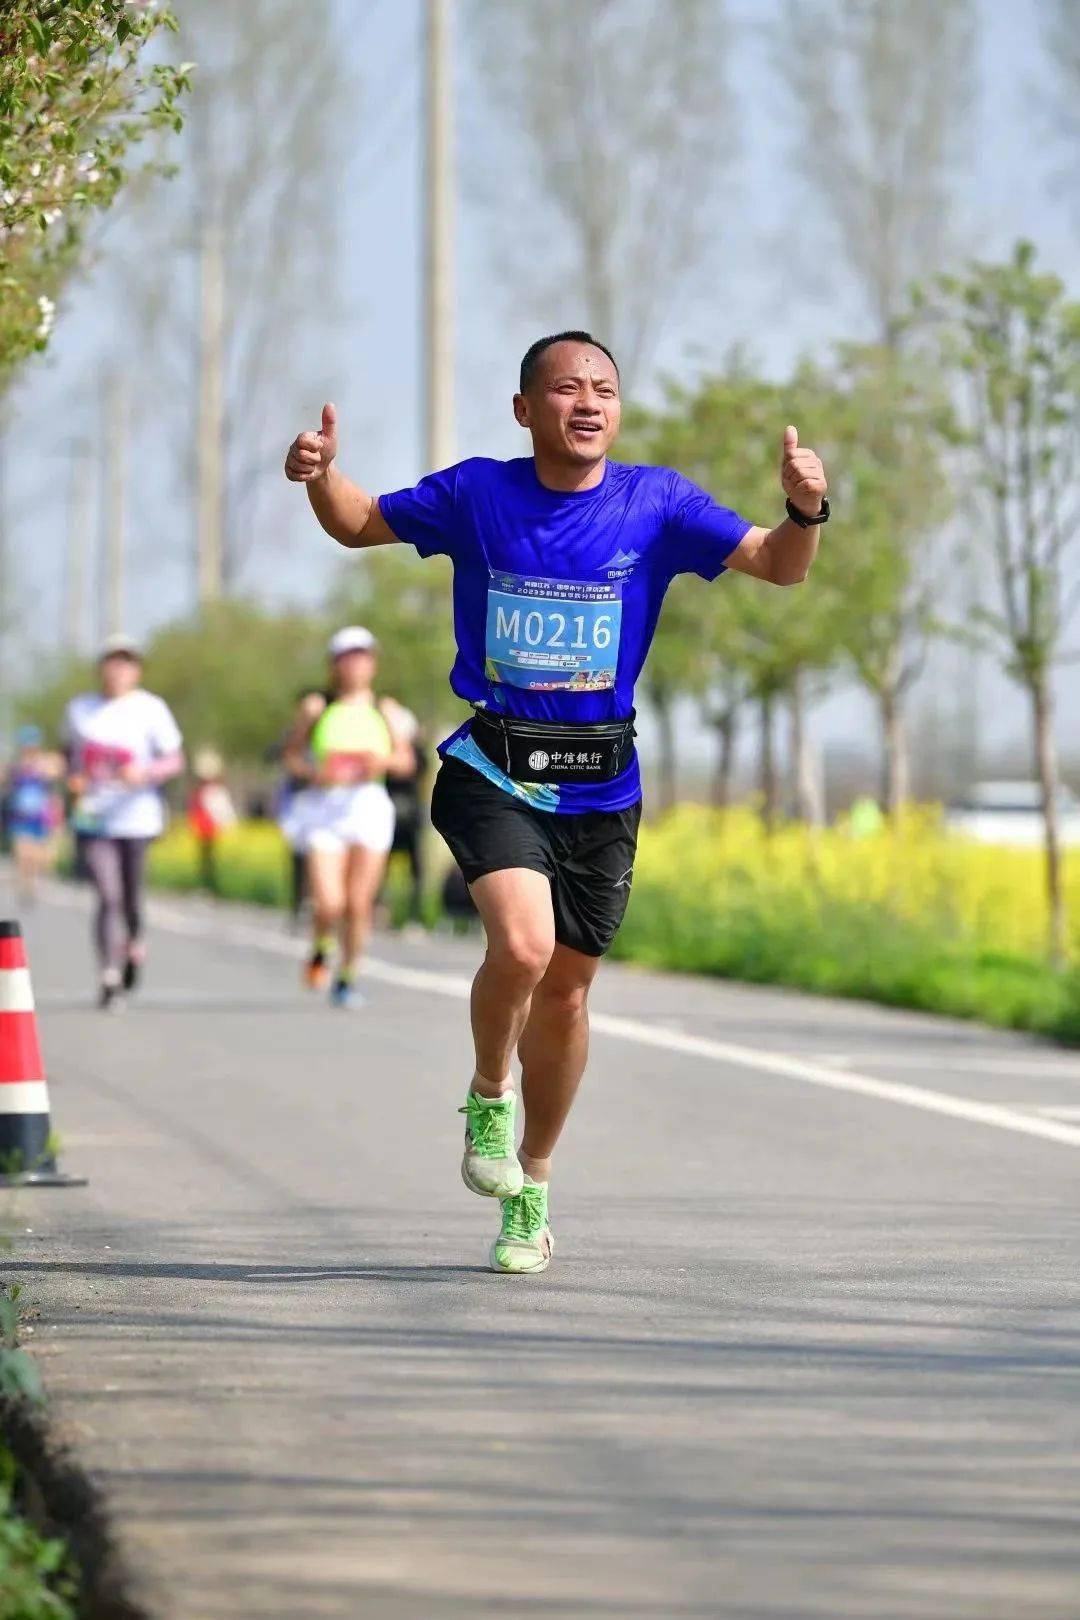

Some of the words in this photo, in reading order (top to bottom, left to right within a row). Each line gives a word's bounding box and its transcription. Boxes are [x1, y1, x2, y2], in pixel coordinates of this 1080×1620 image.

[496, 606, 611, 649] M0216
[551, 751, 603, 764] 中信银行
